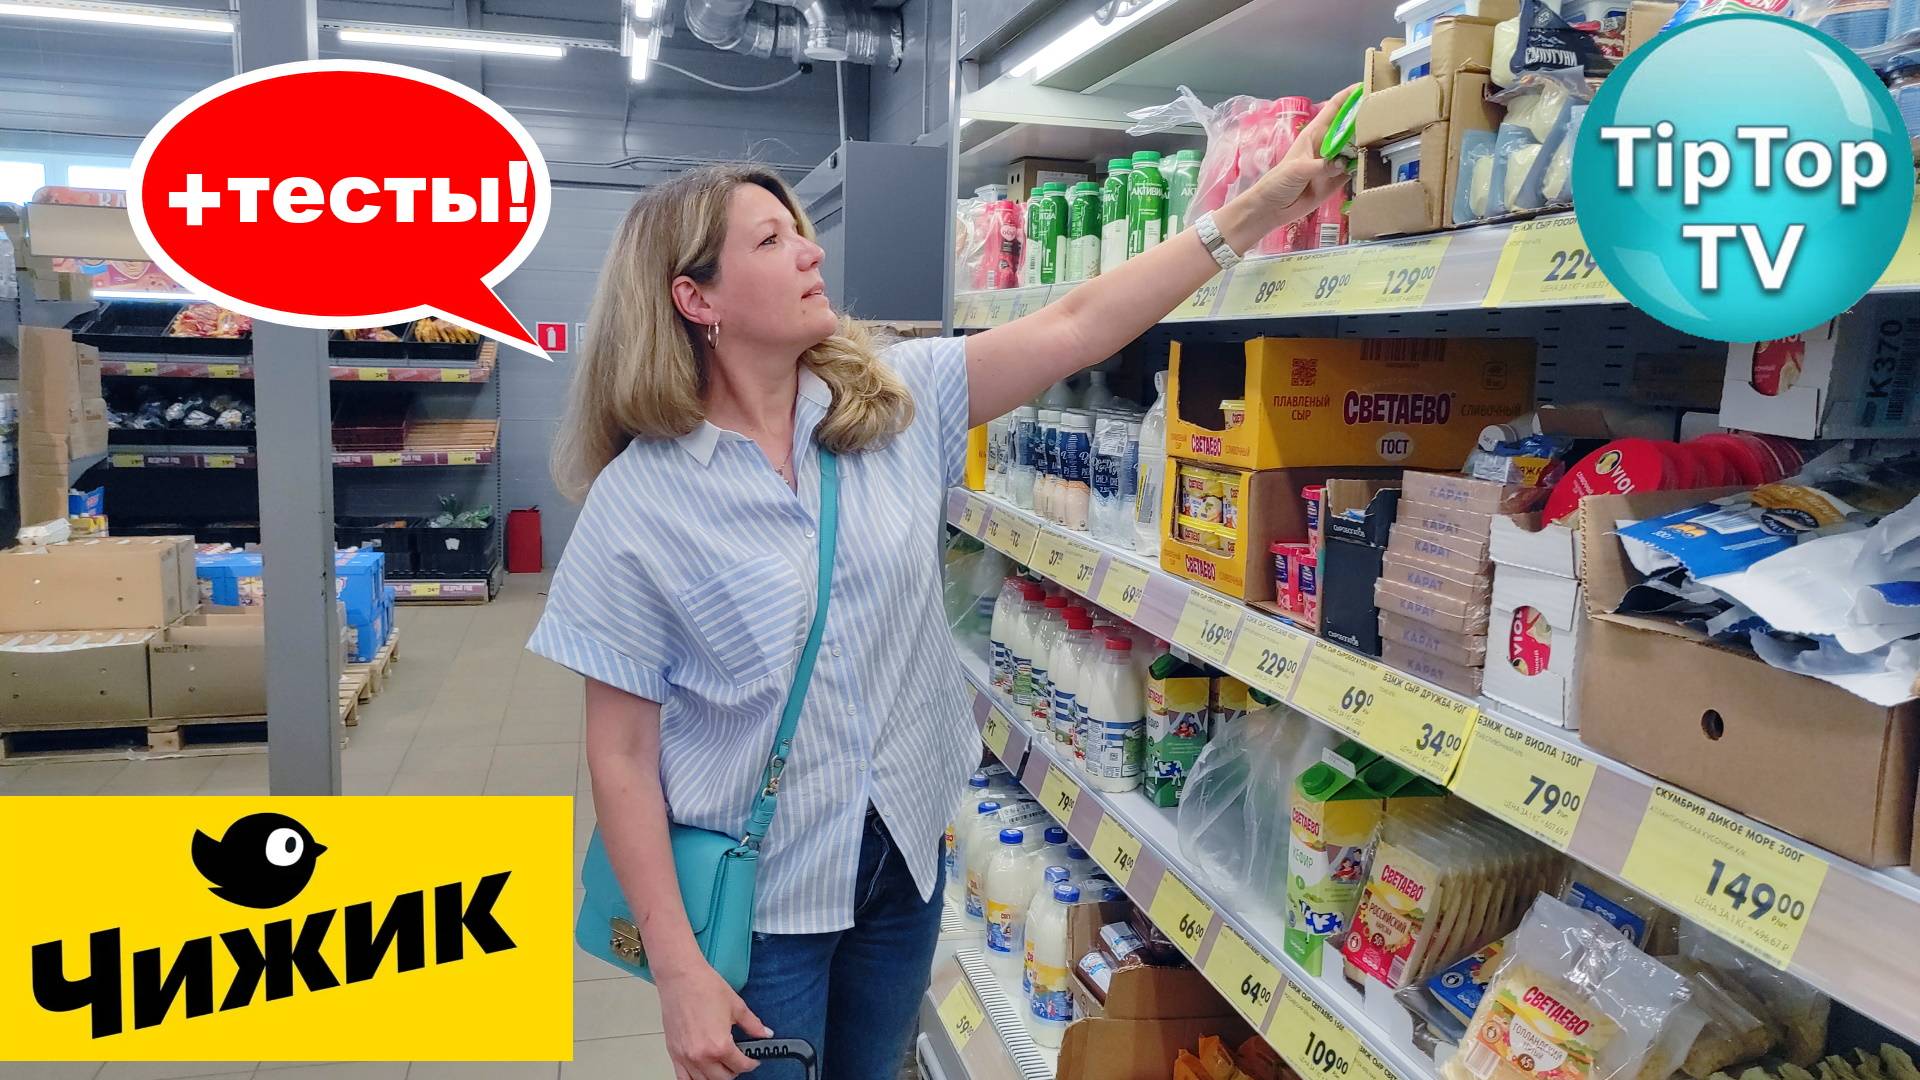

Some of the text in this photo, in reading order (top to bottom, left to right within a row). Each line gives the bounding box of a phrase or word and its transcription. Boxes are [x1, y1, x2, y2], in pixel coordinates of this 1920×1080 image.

[1273, 394, 1330, 408] ПЛАВЛЕНЫЙ
[1343, 390, 1452, 426] СВЕТАЕВО
[1291, 410, 1312, 421] СЫР
[1191, 433, 1222, 457] СВЕТАЕВО
[1381, 438, 1410, 455] ГОСТ
[1414, 540, 1451, 559] КАРАТ
[1184, 554, 1217, 582] СВЕТАЕВО
[1407, 571, 1444, 592] КАРАТ
[1403, 630, 1441, 651] КАРАТ
[1407, 660, 1445, 679] КАРАТ
[1383, 673, 1468, 715] БЗМЖ СЫР ДРУЖБА 90Г
[1477, 715, 1503, 733] БЗМЖ
[1504, 727, 1524, 741] СЫР
[1524, 736, 1558, 758] ВИОЛА
[1560, 751, 1583, 768] 130Г
[1292, 807, 1320, 837] СВЕТАЕВО
[1655, 786, 1805, 863] СКУМБРИЯ ДИКОЕ МОРЕ 300Г
[1380, 864, 1426, 902] СВЕТАЕВО
[1694, 895, 1718, 913] ЦЕНА
[1369, 902, 1408, 934] РОССИЙСКИЙ
[1301, 991, 1312, 1002] СЫР
[1522, 985, 1590, 1036] СВЕТАЕВО
